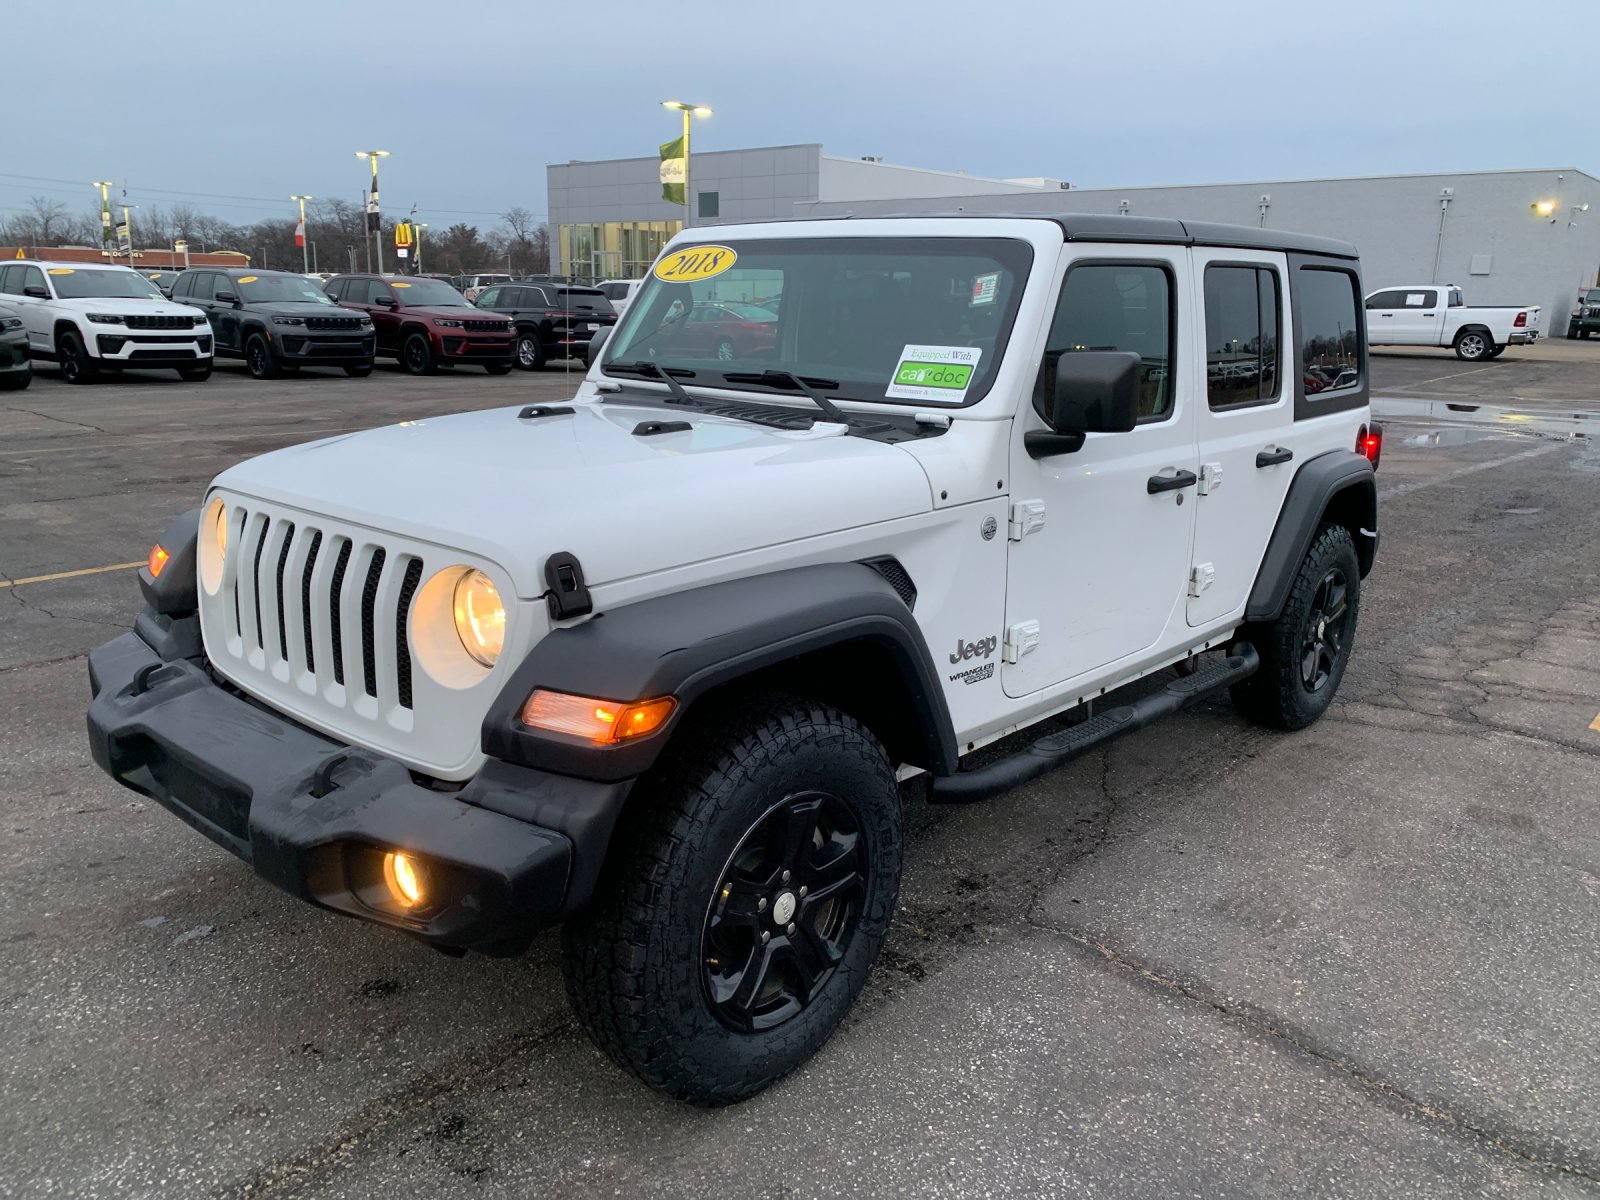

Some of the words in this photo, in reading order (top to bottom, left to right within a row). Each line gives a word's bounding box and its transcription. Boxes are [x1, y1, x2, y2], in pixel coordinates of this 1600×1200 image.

[663, 250, 726, 276] 2018
[911, 349, 951, 360] Equipped
[951, 350, 972, 361] With
[949, 635, 997, 664] Jeep
[949, 662, 995, 682] WRANGLER
